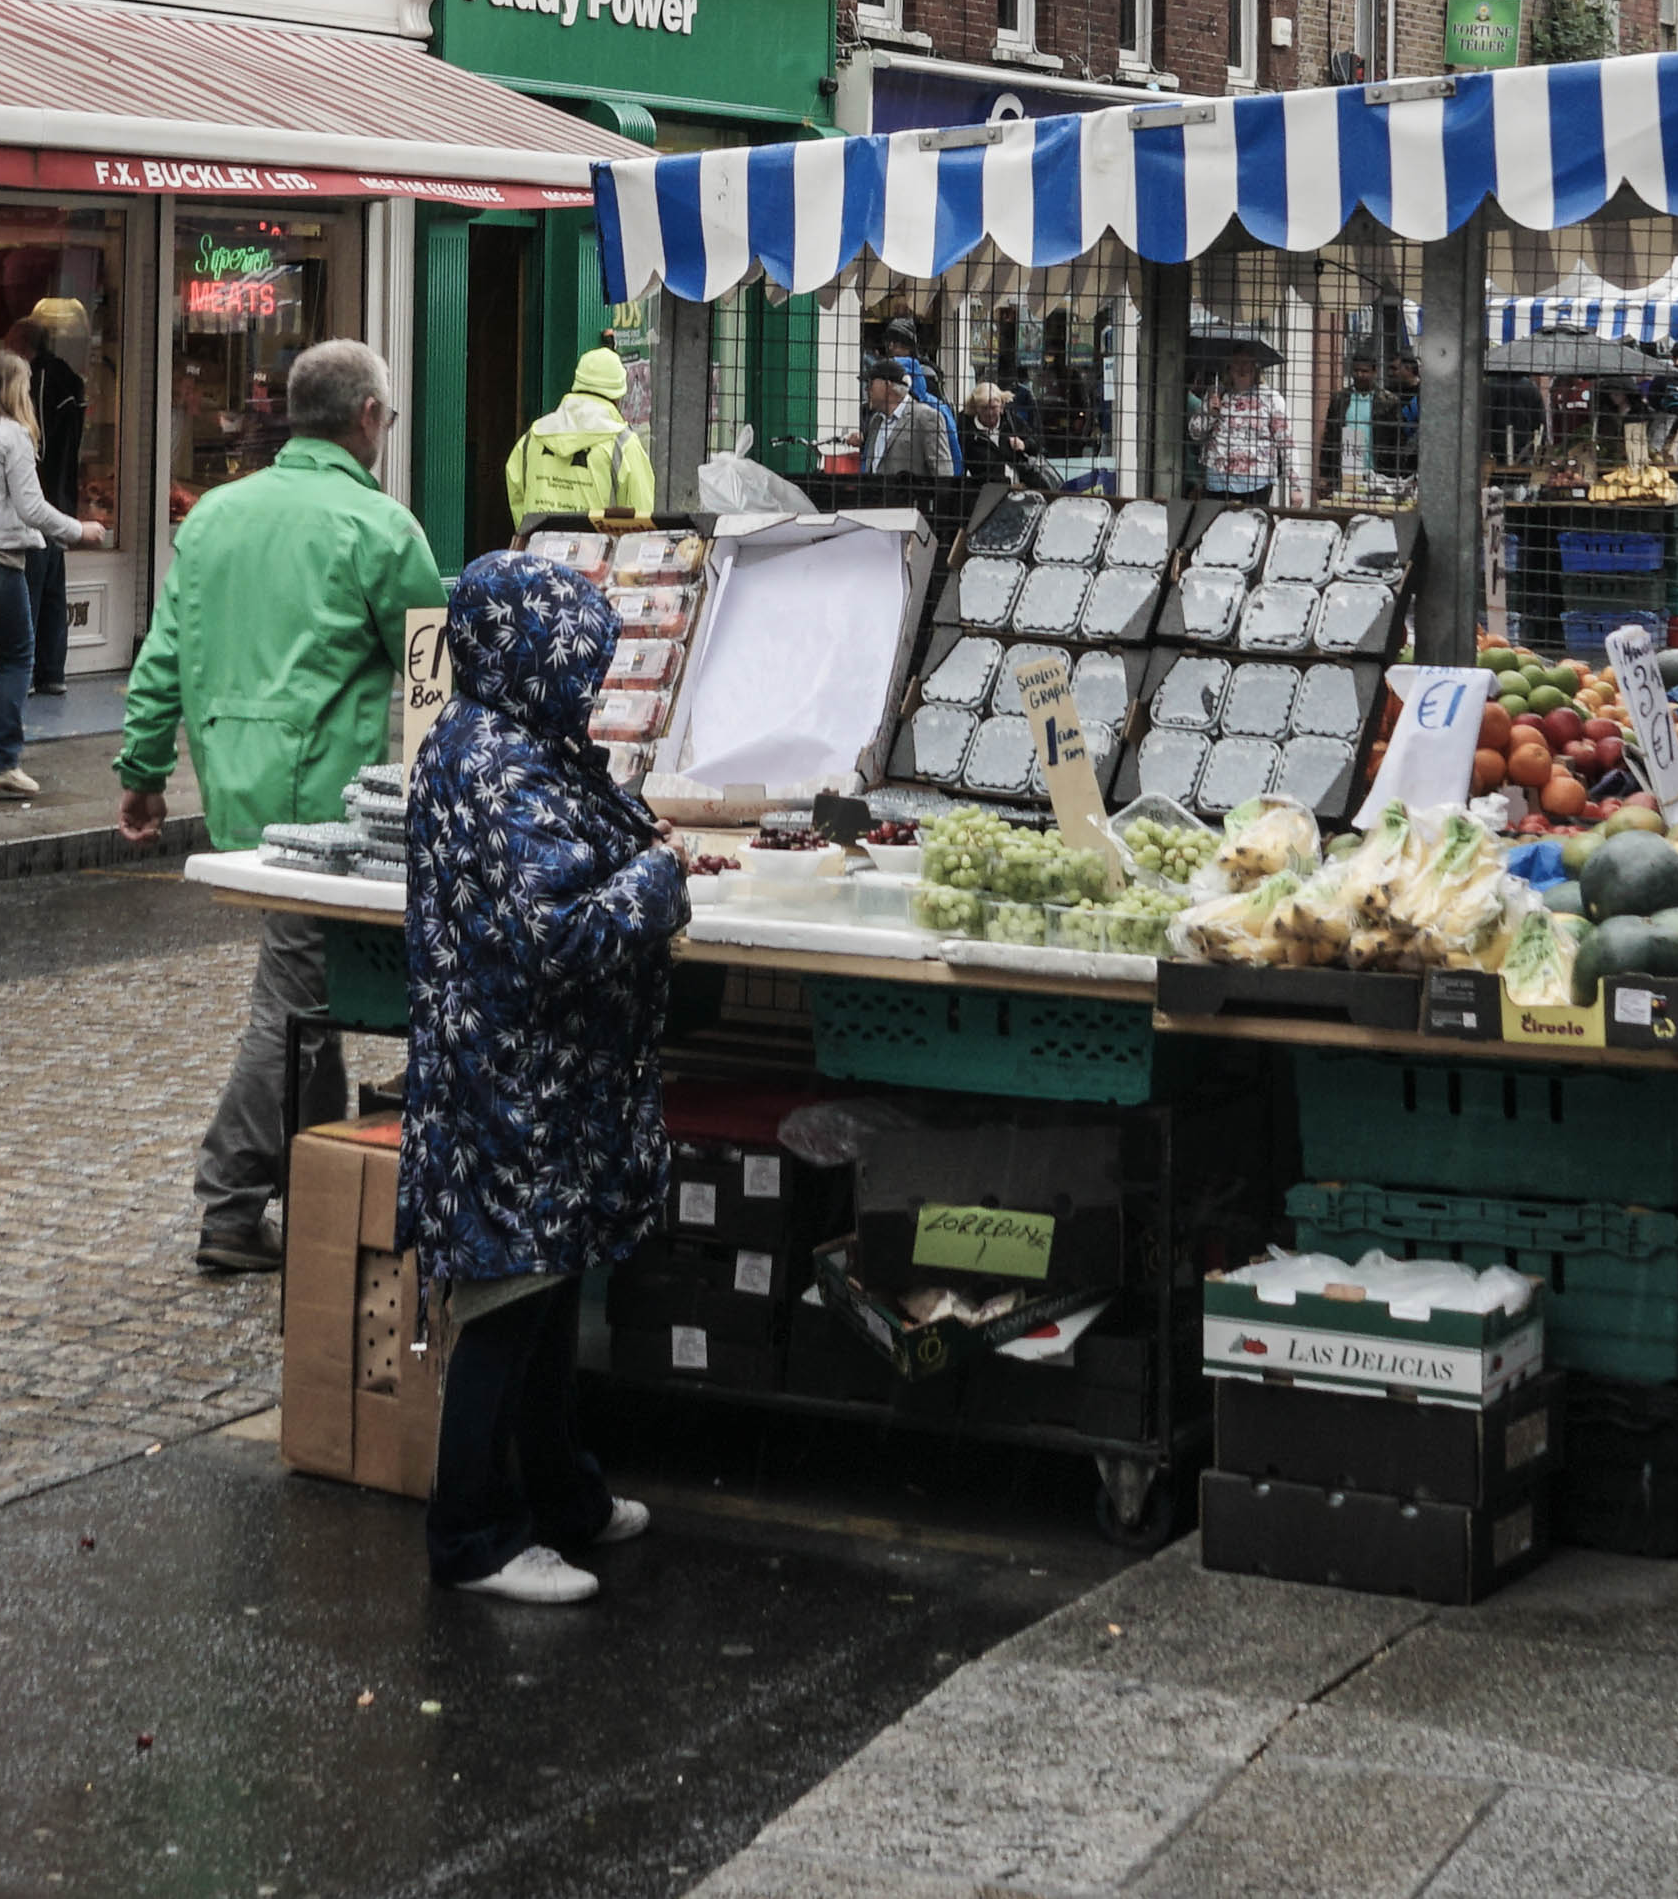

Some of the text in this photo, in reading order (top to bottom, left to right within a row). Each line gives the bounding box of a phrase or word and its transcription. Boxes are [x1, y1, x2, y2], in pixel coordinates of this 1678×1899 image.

[1453, 22, 1515, 39] FORTUNE
[1459, 38, 1506, 53] TELLER
[95, 161, 318, 190] F.X. BUCKLEY LTD.
[427, 181, 506, 203] EXCELLENCE
[189, 280, 275, 316] MEATS
[410, 684, 445, 709] Box
[1417, 679, 1467, 729] €1
[1651, 710, 1674, 770] €1
[1522, 1019, 1584, 1036] Ciruelo
[1288, 1338, 1455, 1381] LAS DELICIAS
